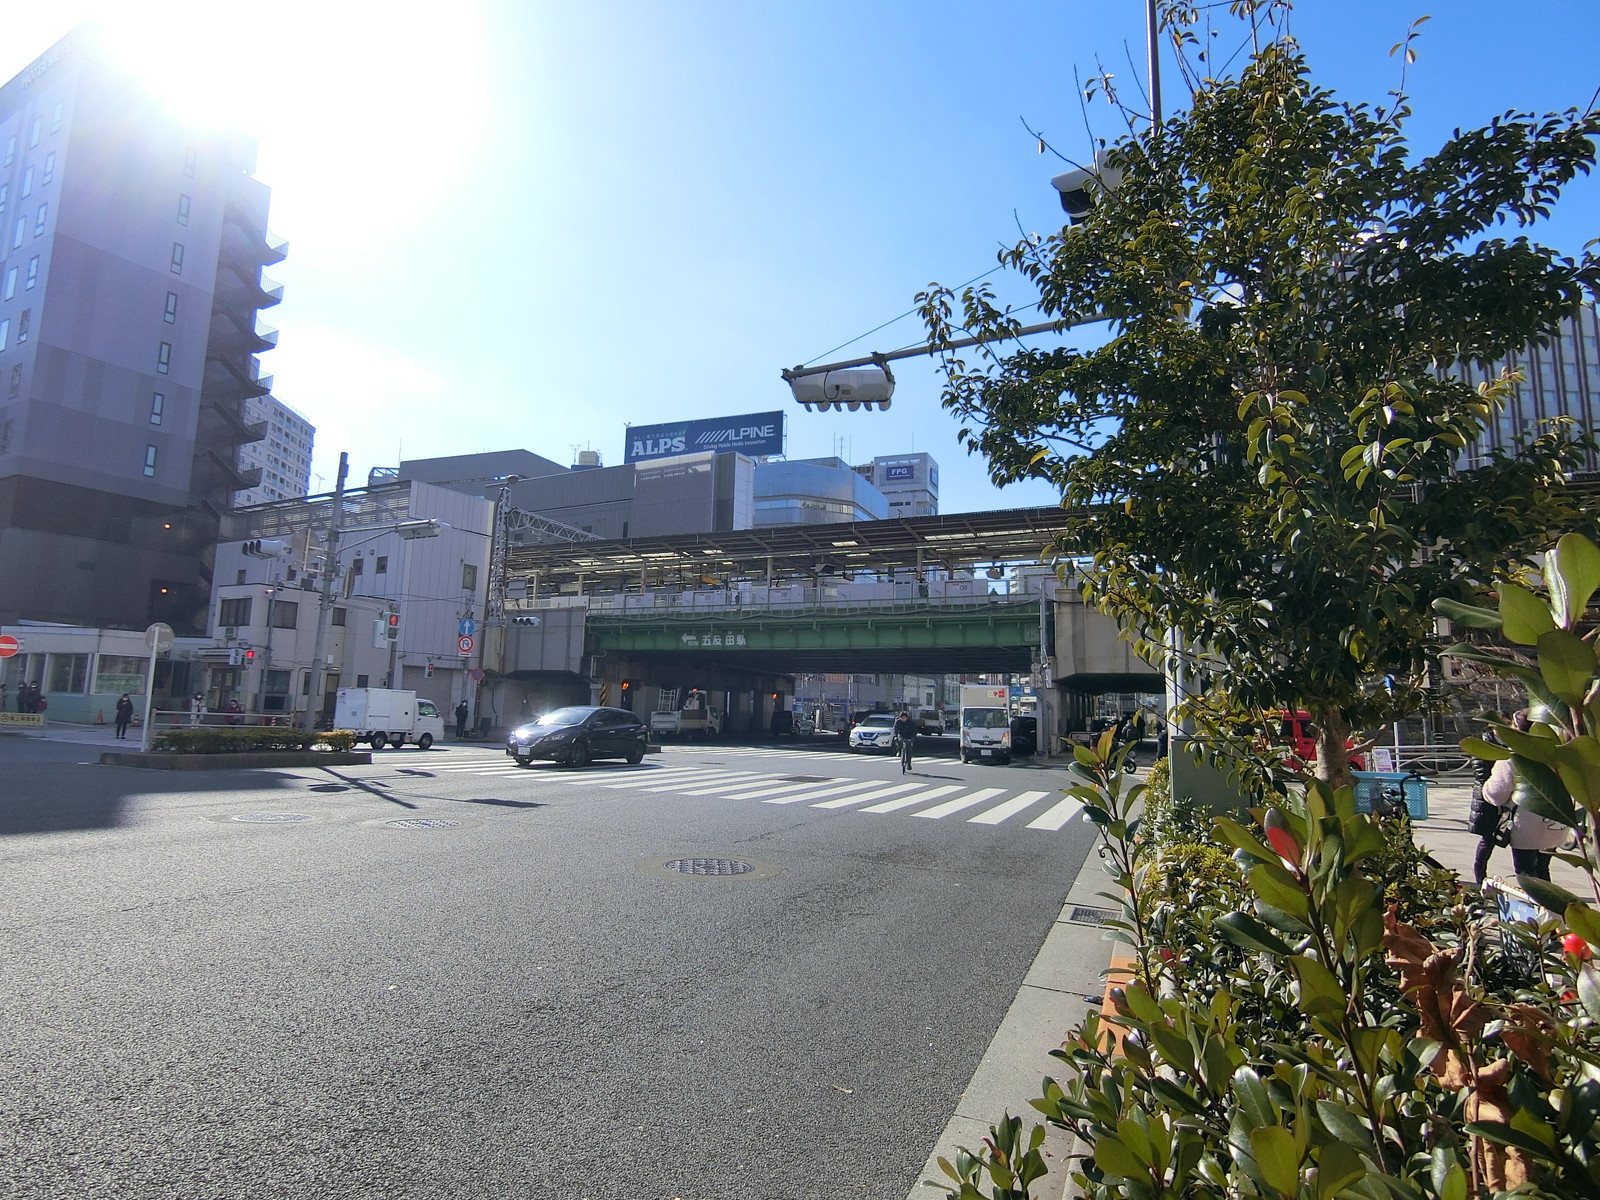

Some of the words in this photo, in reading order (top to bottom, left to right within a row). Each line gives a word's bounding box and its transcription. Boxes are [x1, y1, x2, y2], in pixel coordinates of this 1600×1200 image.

[23, 60, 48, 88] HOTEL
[719, 424, 775, 442] ALPINE
[631, 436, 687, 457] ALPS
[718, 441, 731, 449] Mobile
[744, 438, 767, 446] Innovation
[702, 634, 747, 646] 五反田駅
